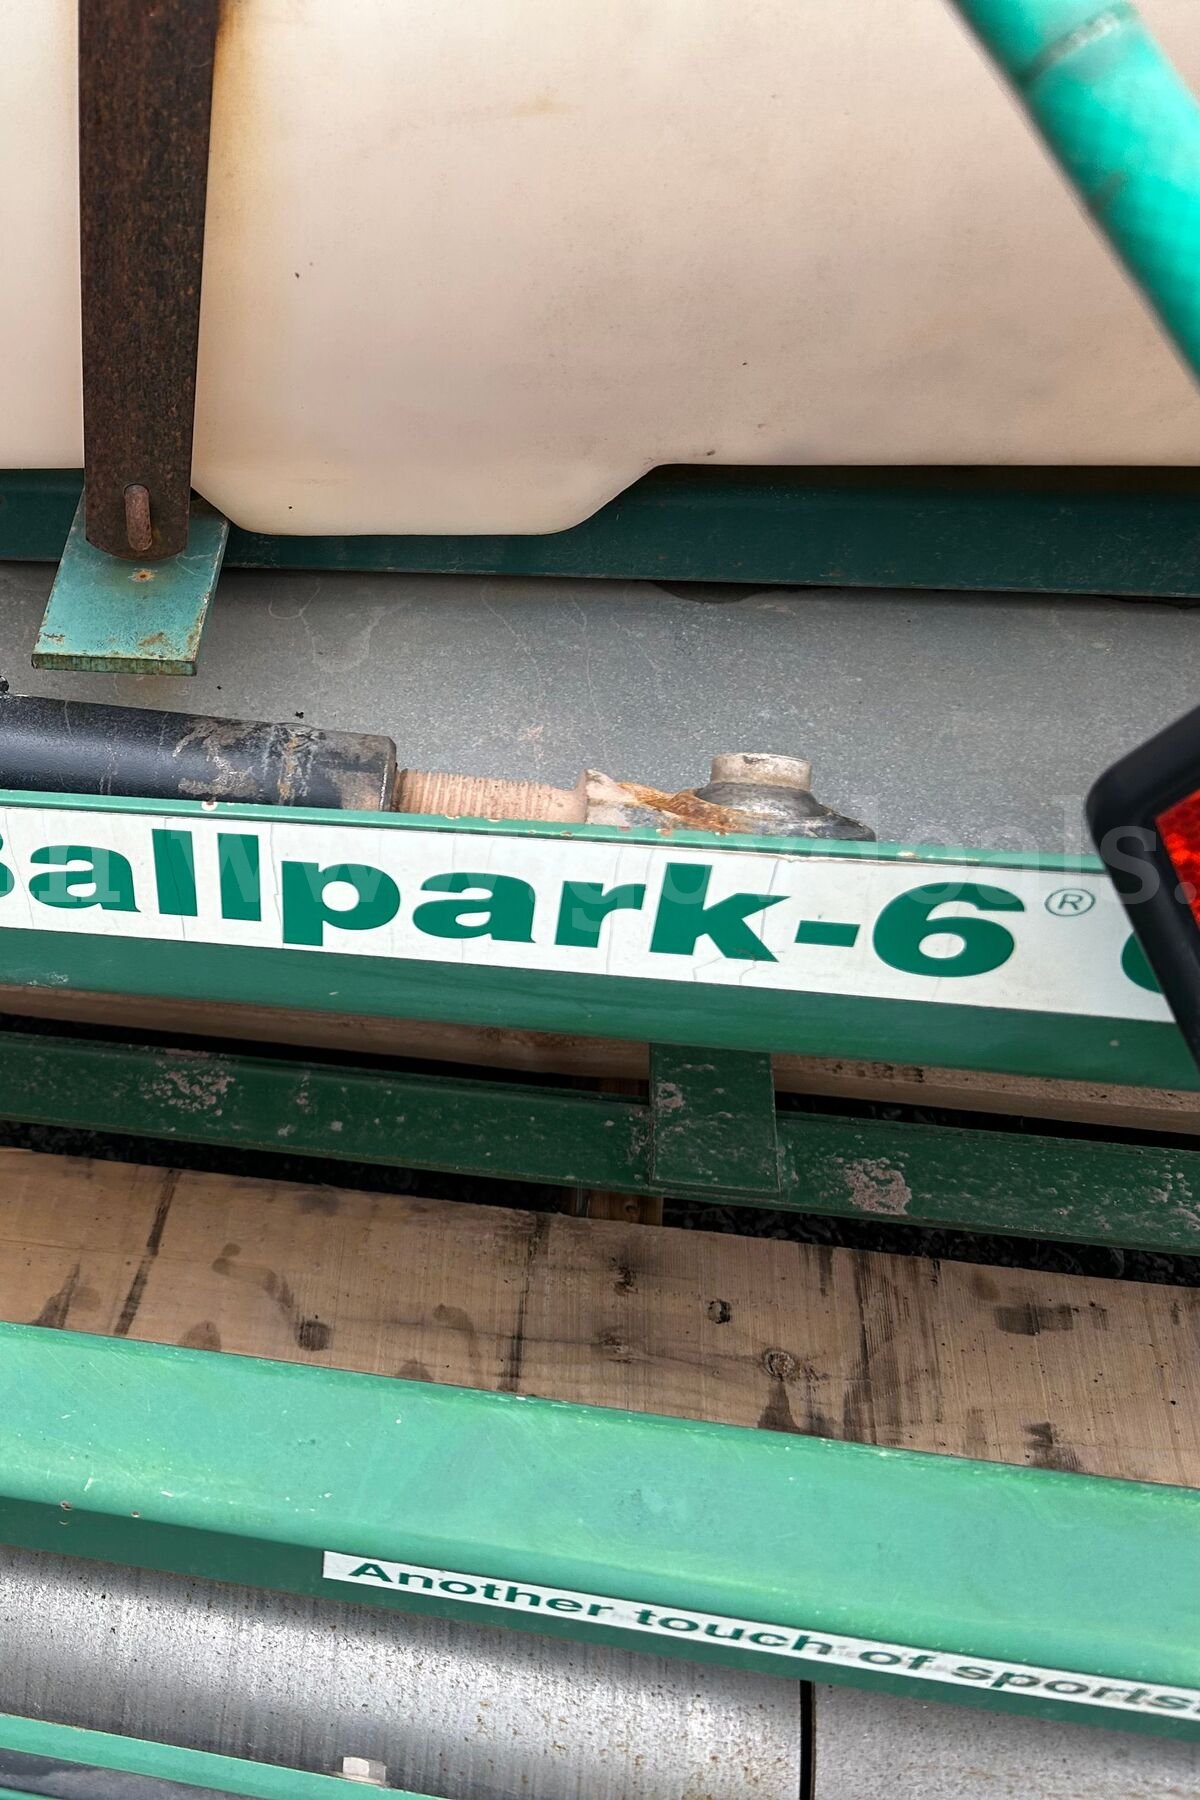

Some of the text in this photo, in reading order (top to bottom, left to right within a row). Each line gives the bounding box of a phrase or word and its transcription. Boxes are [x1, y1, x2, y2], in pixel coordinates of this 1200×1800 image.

[348, 1562, 1200, 1713] Another touch of sports
